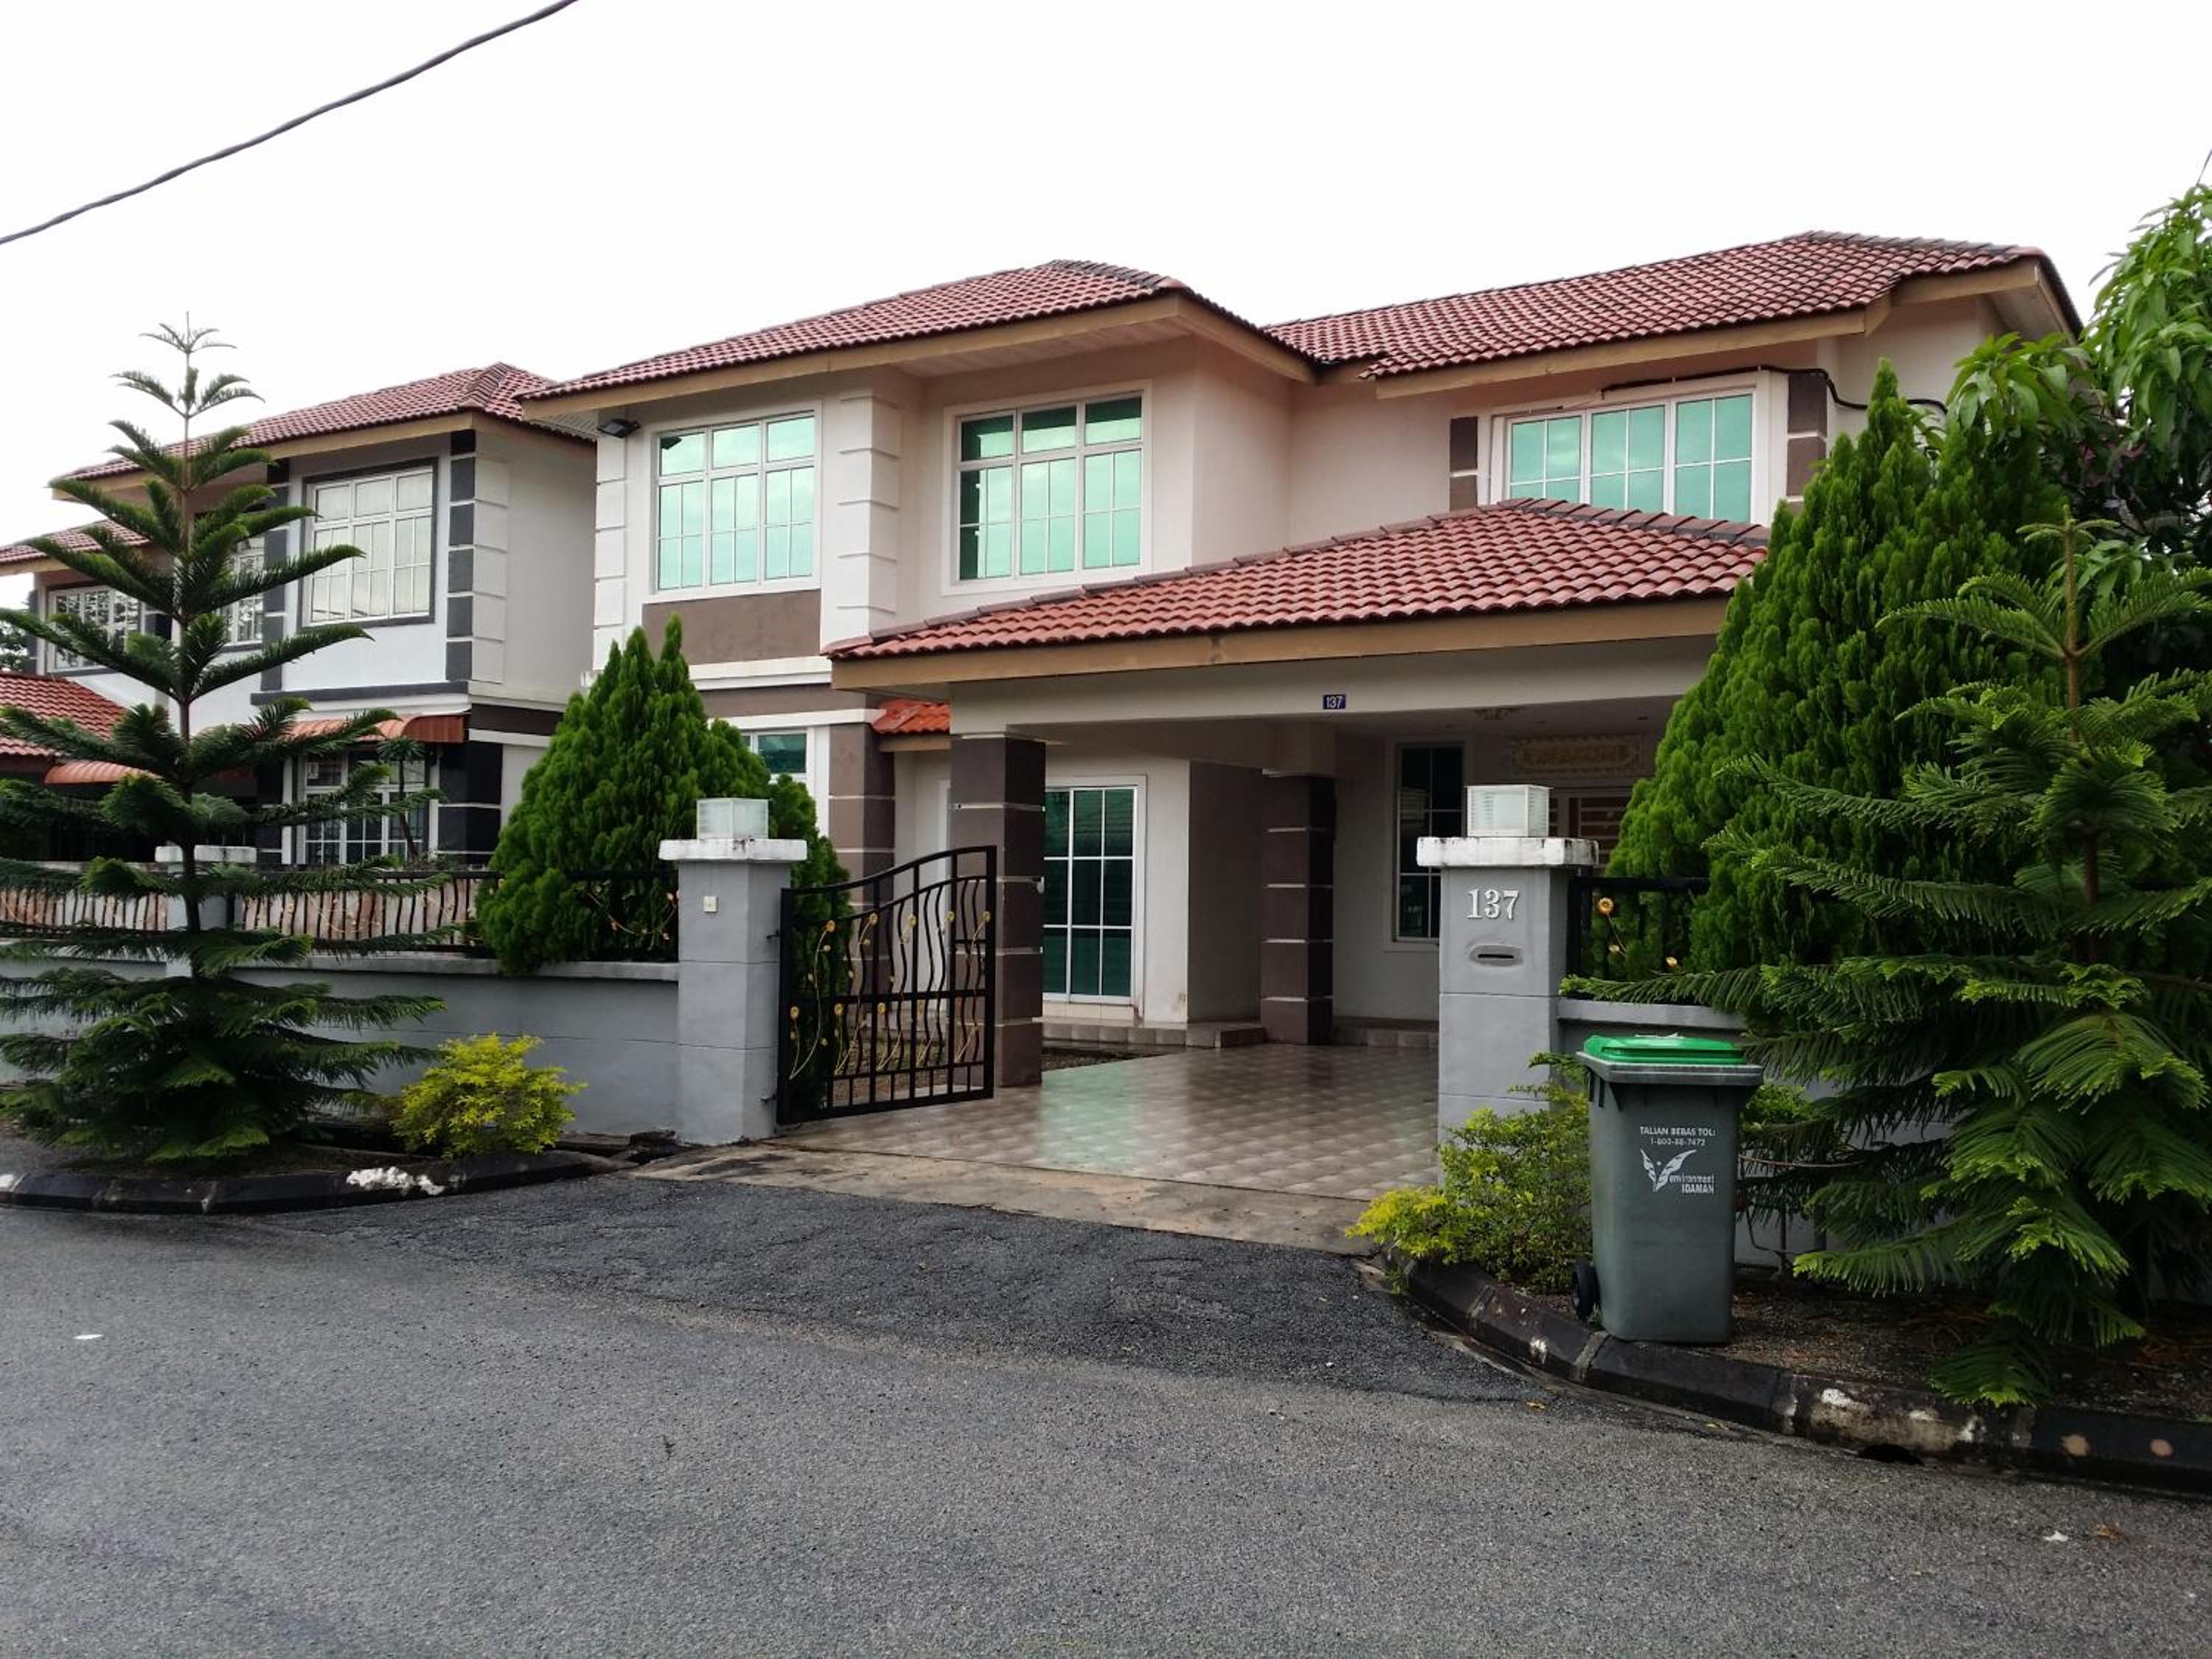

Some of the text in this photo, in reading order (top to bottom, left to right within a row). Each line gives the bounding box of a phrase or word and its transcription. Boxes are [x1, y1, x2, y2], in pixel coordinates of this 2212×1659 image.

[1326, 695, 1343, 709] 137
[1467, 888, 1520, 919] 137
[1639, 1126, 1716, 1136] TALIAN BEBAS TOL:
[1682, 1183, 1714, 1194] IDAMAN
